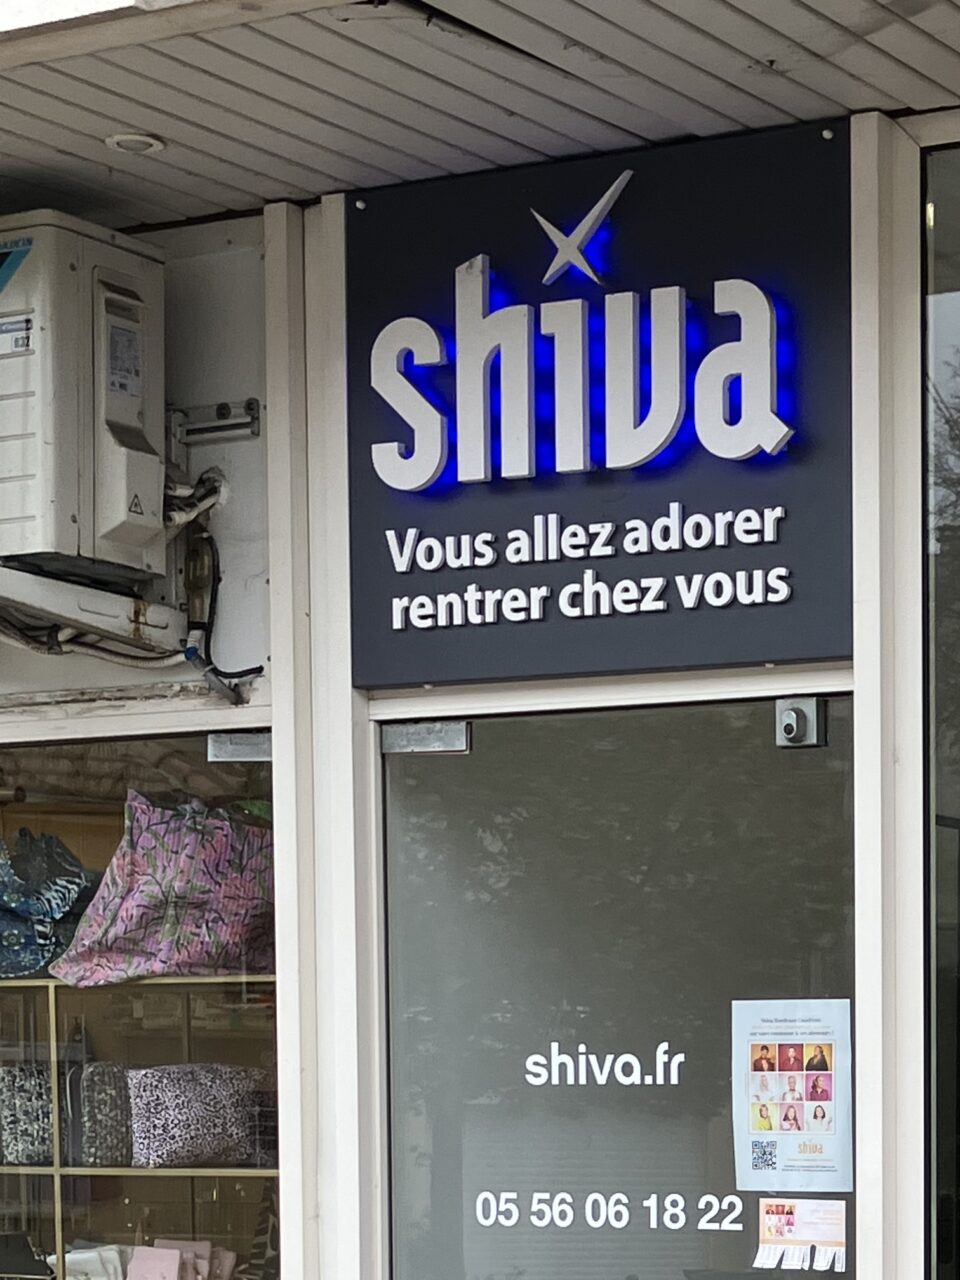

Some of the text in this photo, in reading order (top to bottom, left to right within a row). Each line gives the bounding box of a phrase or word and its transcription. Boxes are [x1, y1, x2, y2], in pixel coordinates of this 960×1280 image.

[371, 253, 796, 492] shiva
[385, 502, 785, 573] Vous allez adorer
[392, 566, 791, 630] rentrer chez vous
[525, 1041, 686, 1086] shiva.fr
[476, 1191, 744, 1231] 05 56 06 18 22
